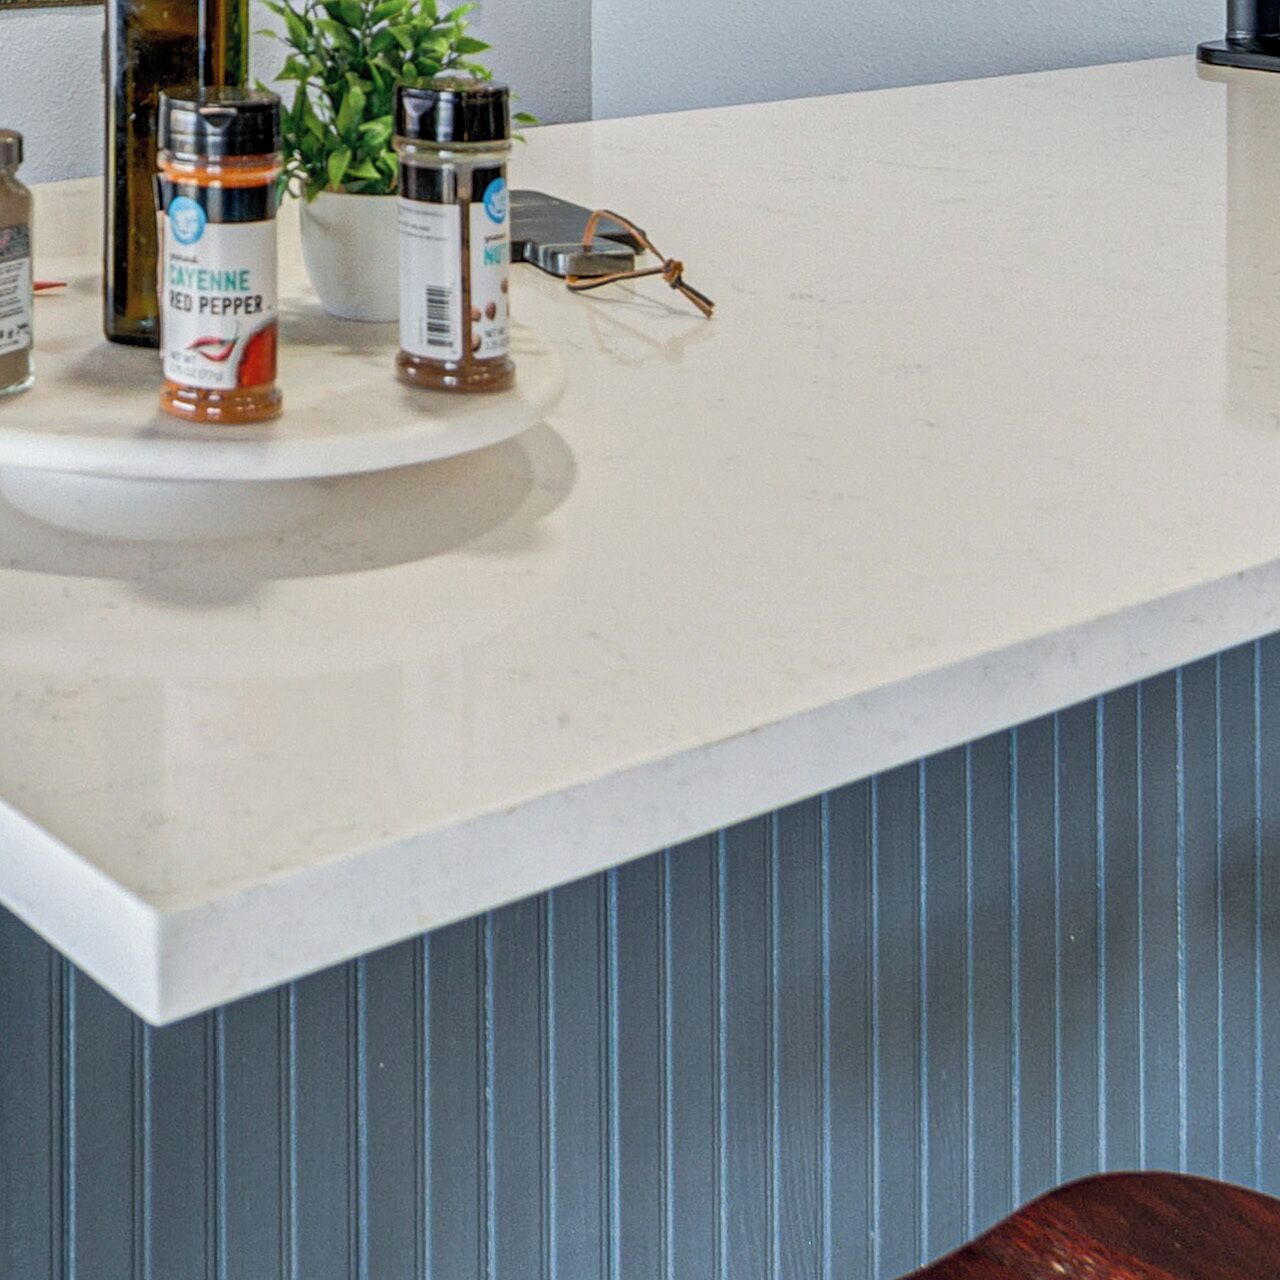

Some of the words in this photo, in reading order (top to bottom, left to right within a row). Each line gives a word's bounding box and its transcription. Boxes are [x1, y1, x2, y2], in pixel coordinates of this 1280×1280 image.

[168, 265, 251, 292] CAYENNE
[169, 290, 194, 312] RED
[198, 295, 264, 316] PEPPER
